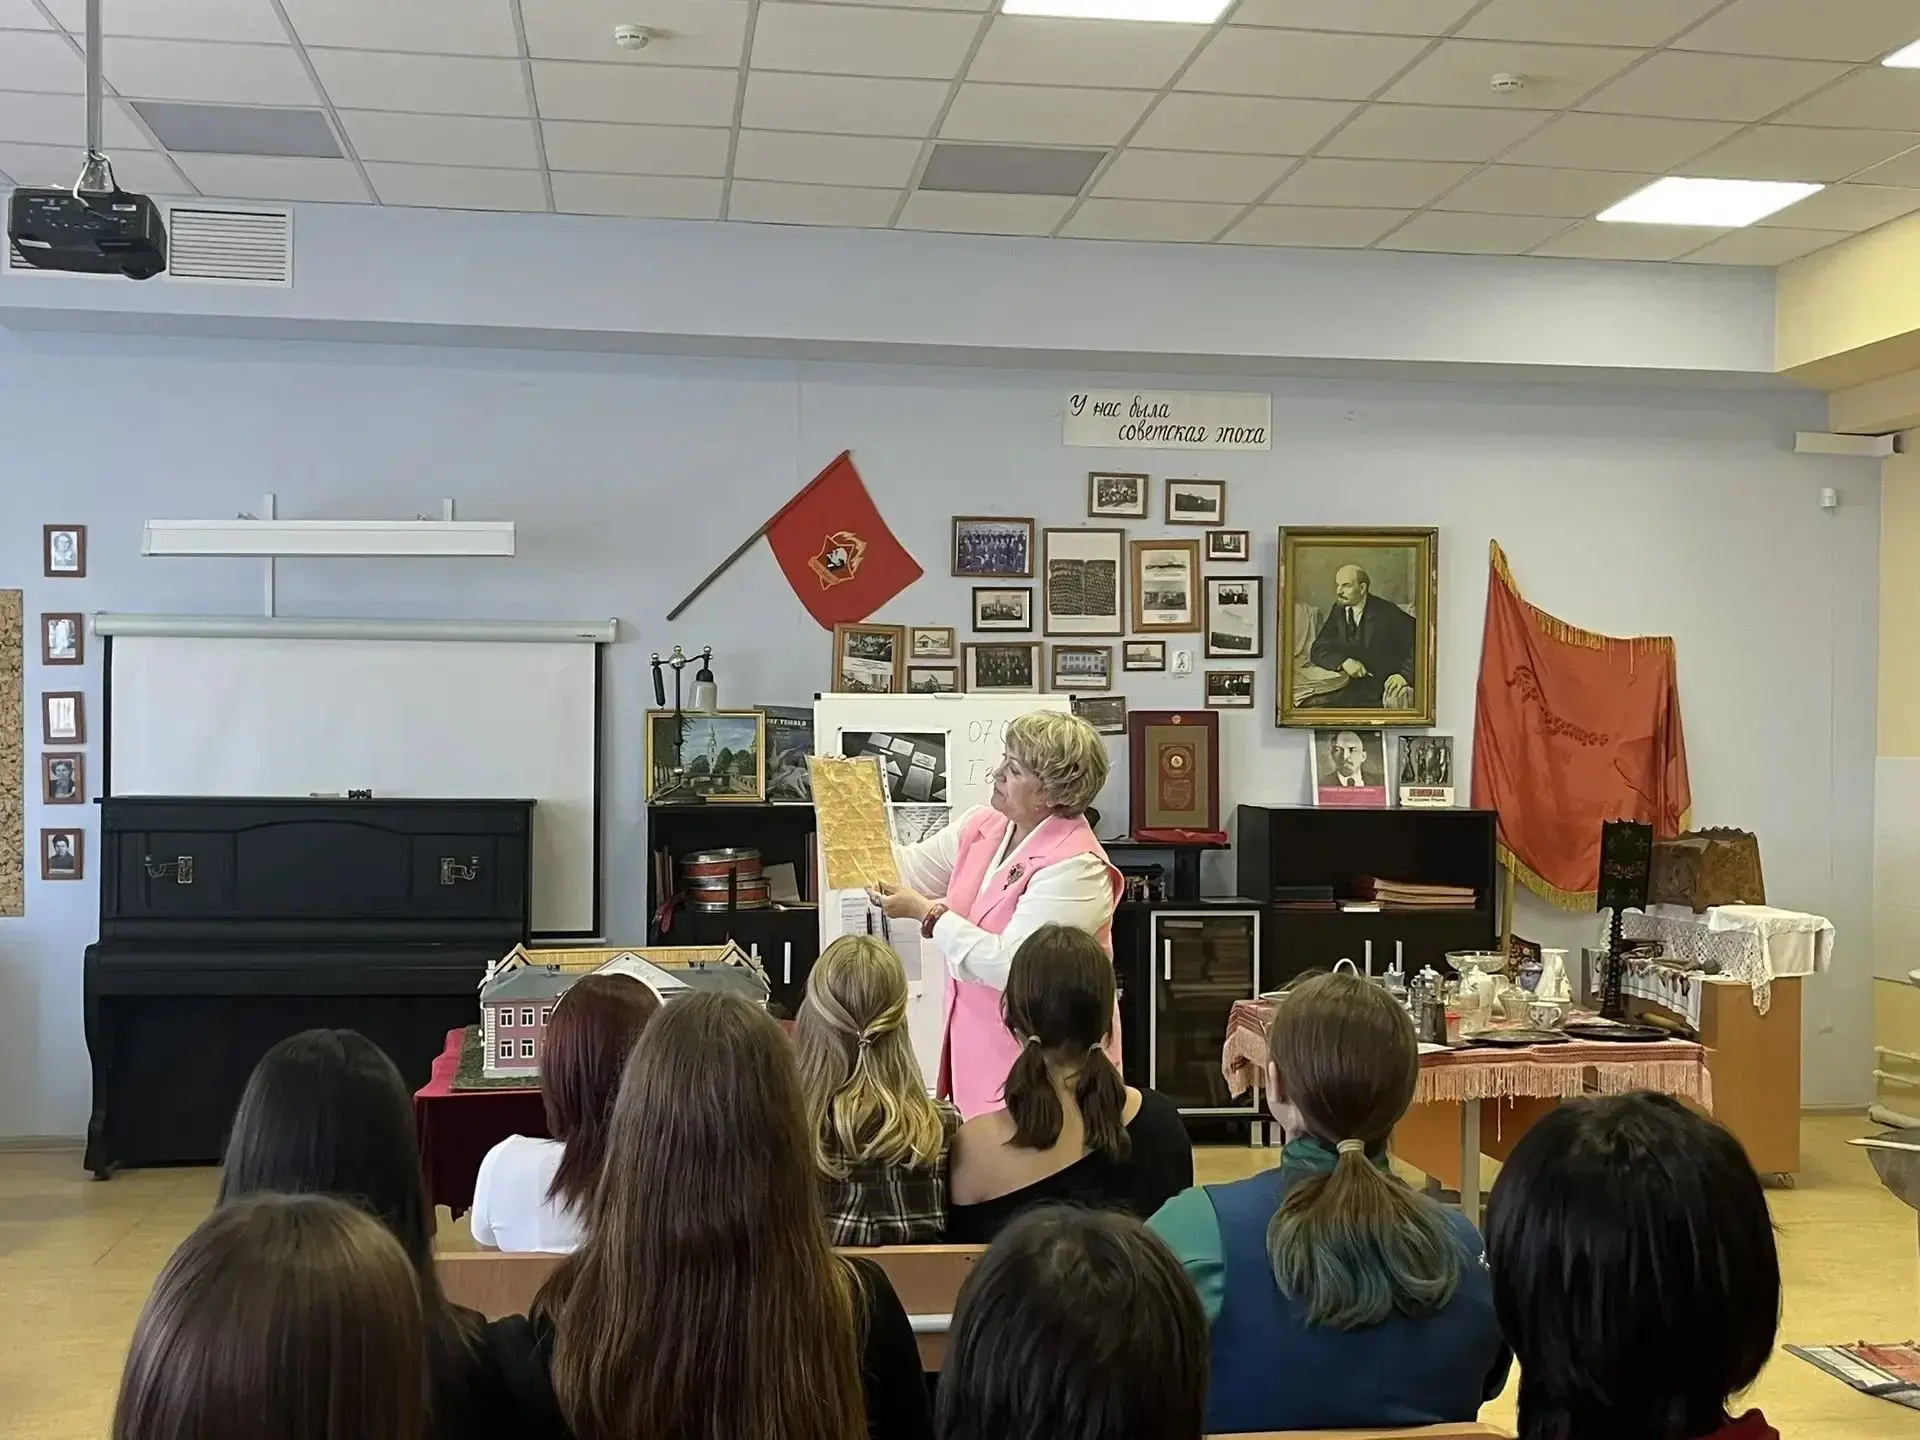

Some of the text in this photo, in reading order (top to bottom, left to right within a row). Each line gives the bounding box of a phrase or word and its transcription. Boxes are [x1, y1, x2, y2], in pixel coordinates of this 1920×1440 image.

[1069, 394, 1171, 419] У нас была
[1118, 419, 1267, 444] советская эпоха
